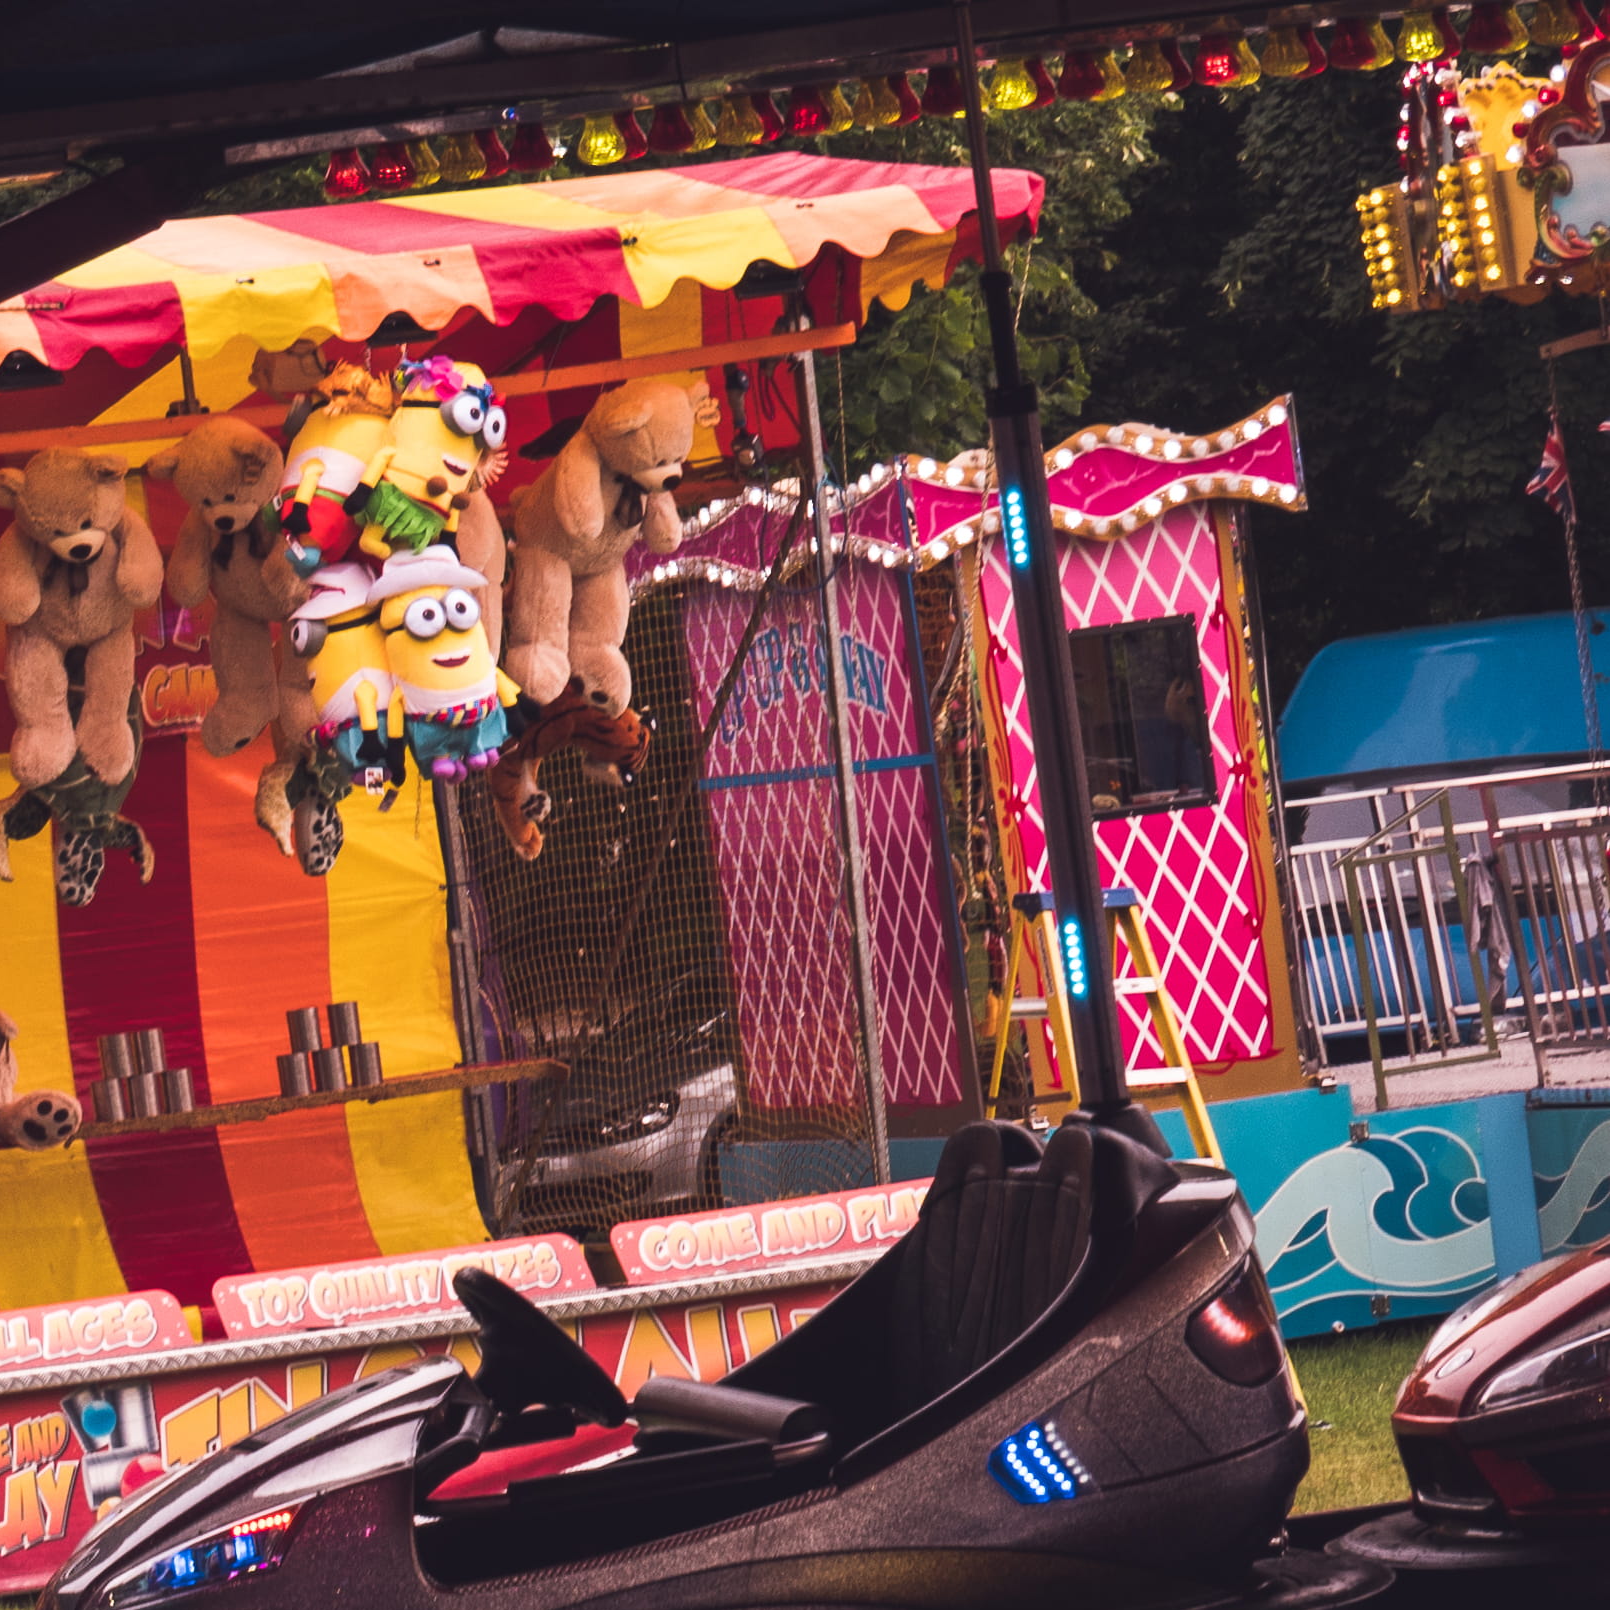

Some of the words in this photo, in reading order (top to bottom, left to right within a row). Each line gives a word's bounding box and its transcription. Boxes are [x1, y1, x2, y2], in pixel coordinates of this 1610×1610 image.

[141, 663, 222, 728] GAM
[639, 1213, 761, 1270] COME
[761, 1202, 847, 1257] AND
[846, 1187, 930, 1242] PLA
[238, 1276, 308, 1328] TOP
[310, 1259, 442, 1324] QUALITY
[43, 1299, 158, 1360] AGES
[12, 1411, 70, 1472] AND
